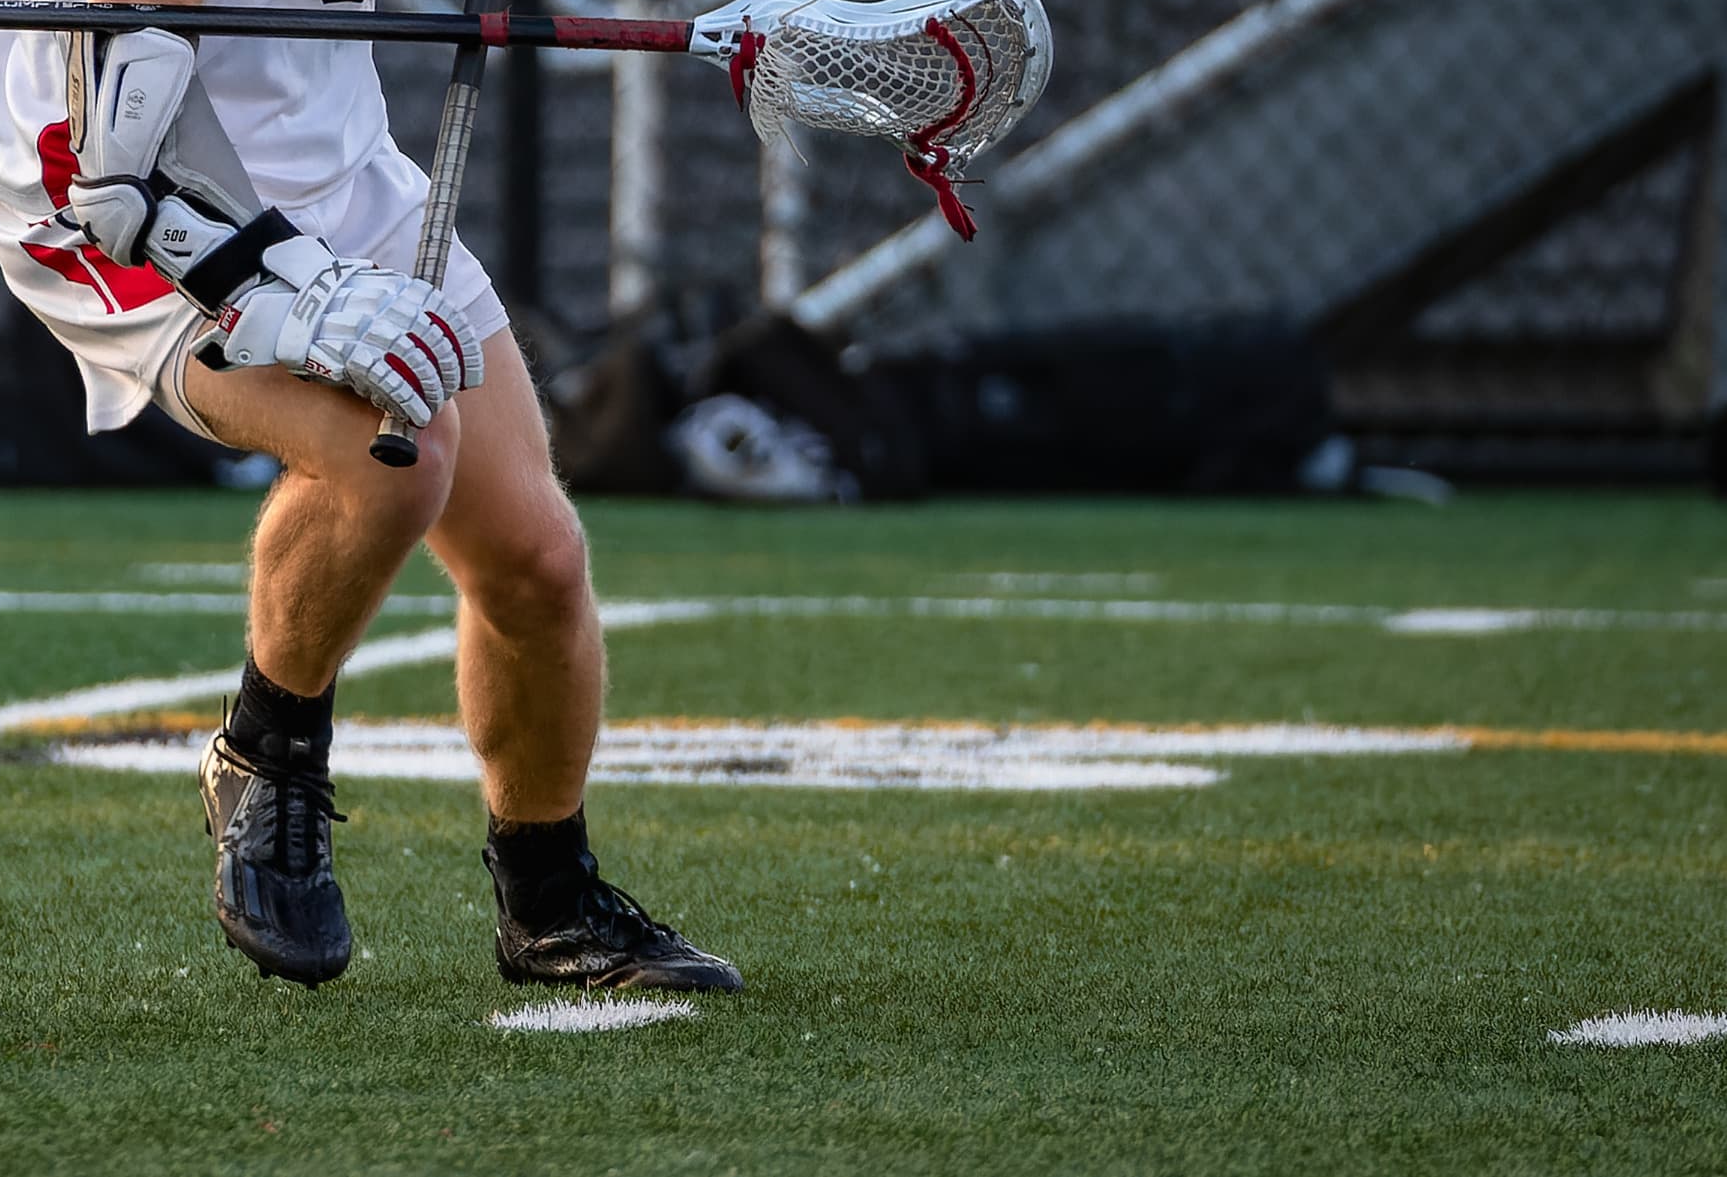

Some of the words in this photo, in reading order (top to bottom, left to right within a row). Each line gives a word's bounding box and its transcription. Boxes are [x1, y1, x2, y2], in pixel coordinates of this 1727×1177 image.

[162, 228, 188, 243] 500
[292, 259, 355, 325] STX
[304, 357, 333, 378] STX
